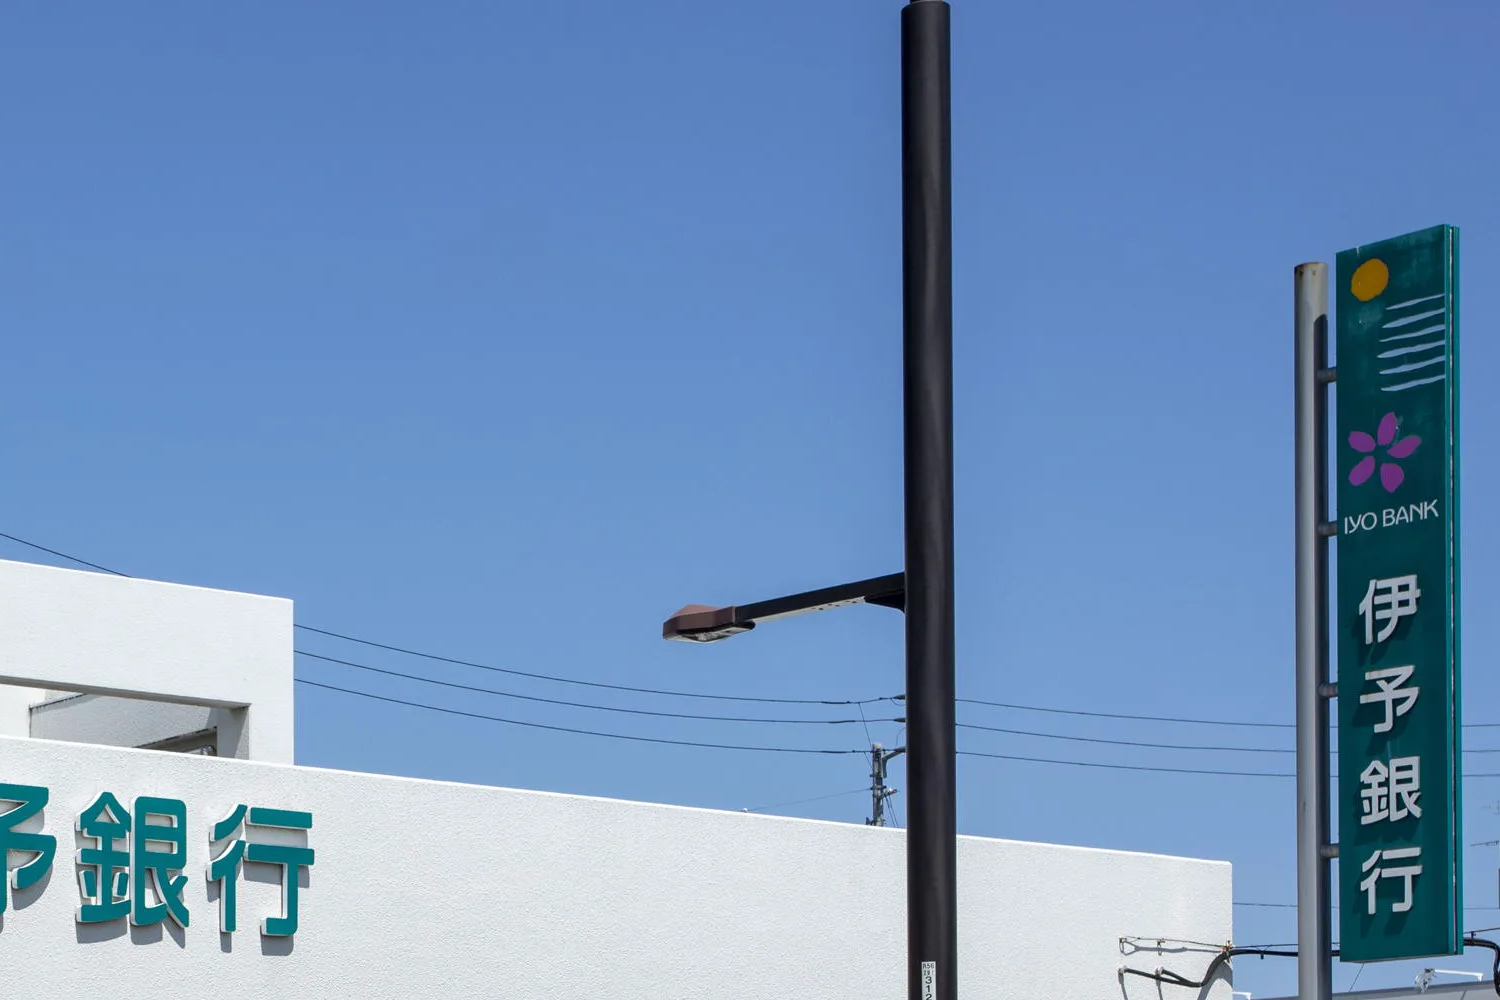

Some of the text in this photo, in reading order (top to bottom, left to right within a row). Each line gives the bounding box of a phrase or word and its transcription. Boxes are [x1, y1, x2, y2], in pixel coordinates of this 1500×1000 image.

[1343, 499, 1439, 535] IYO BANK
[1358, 573, 1422, 916] 伊予銀行
